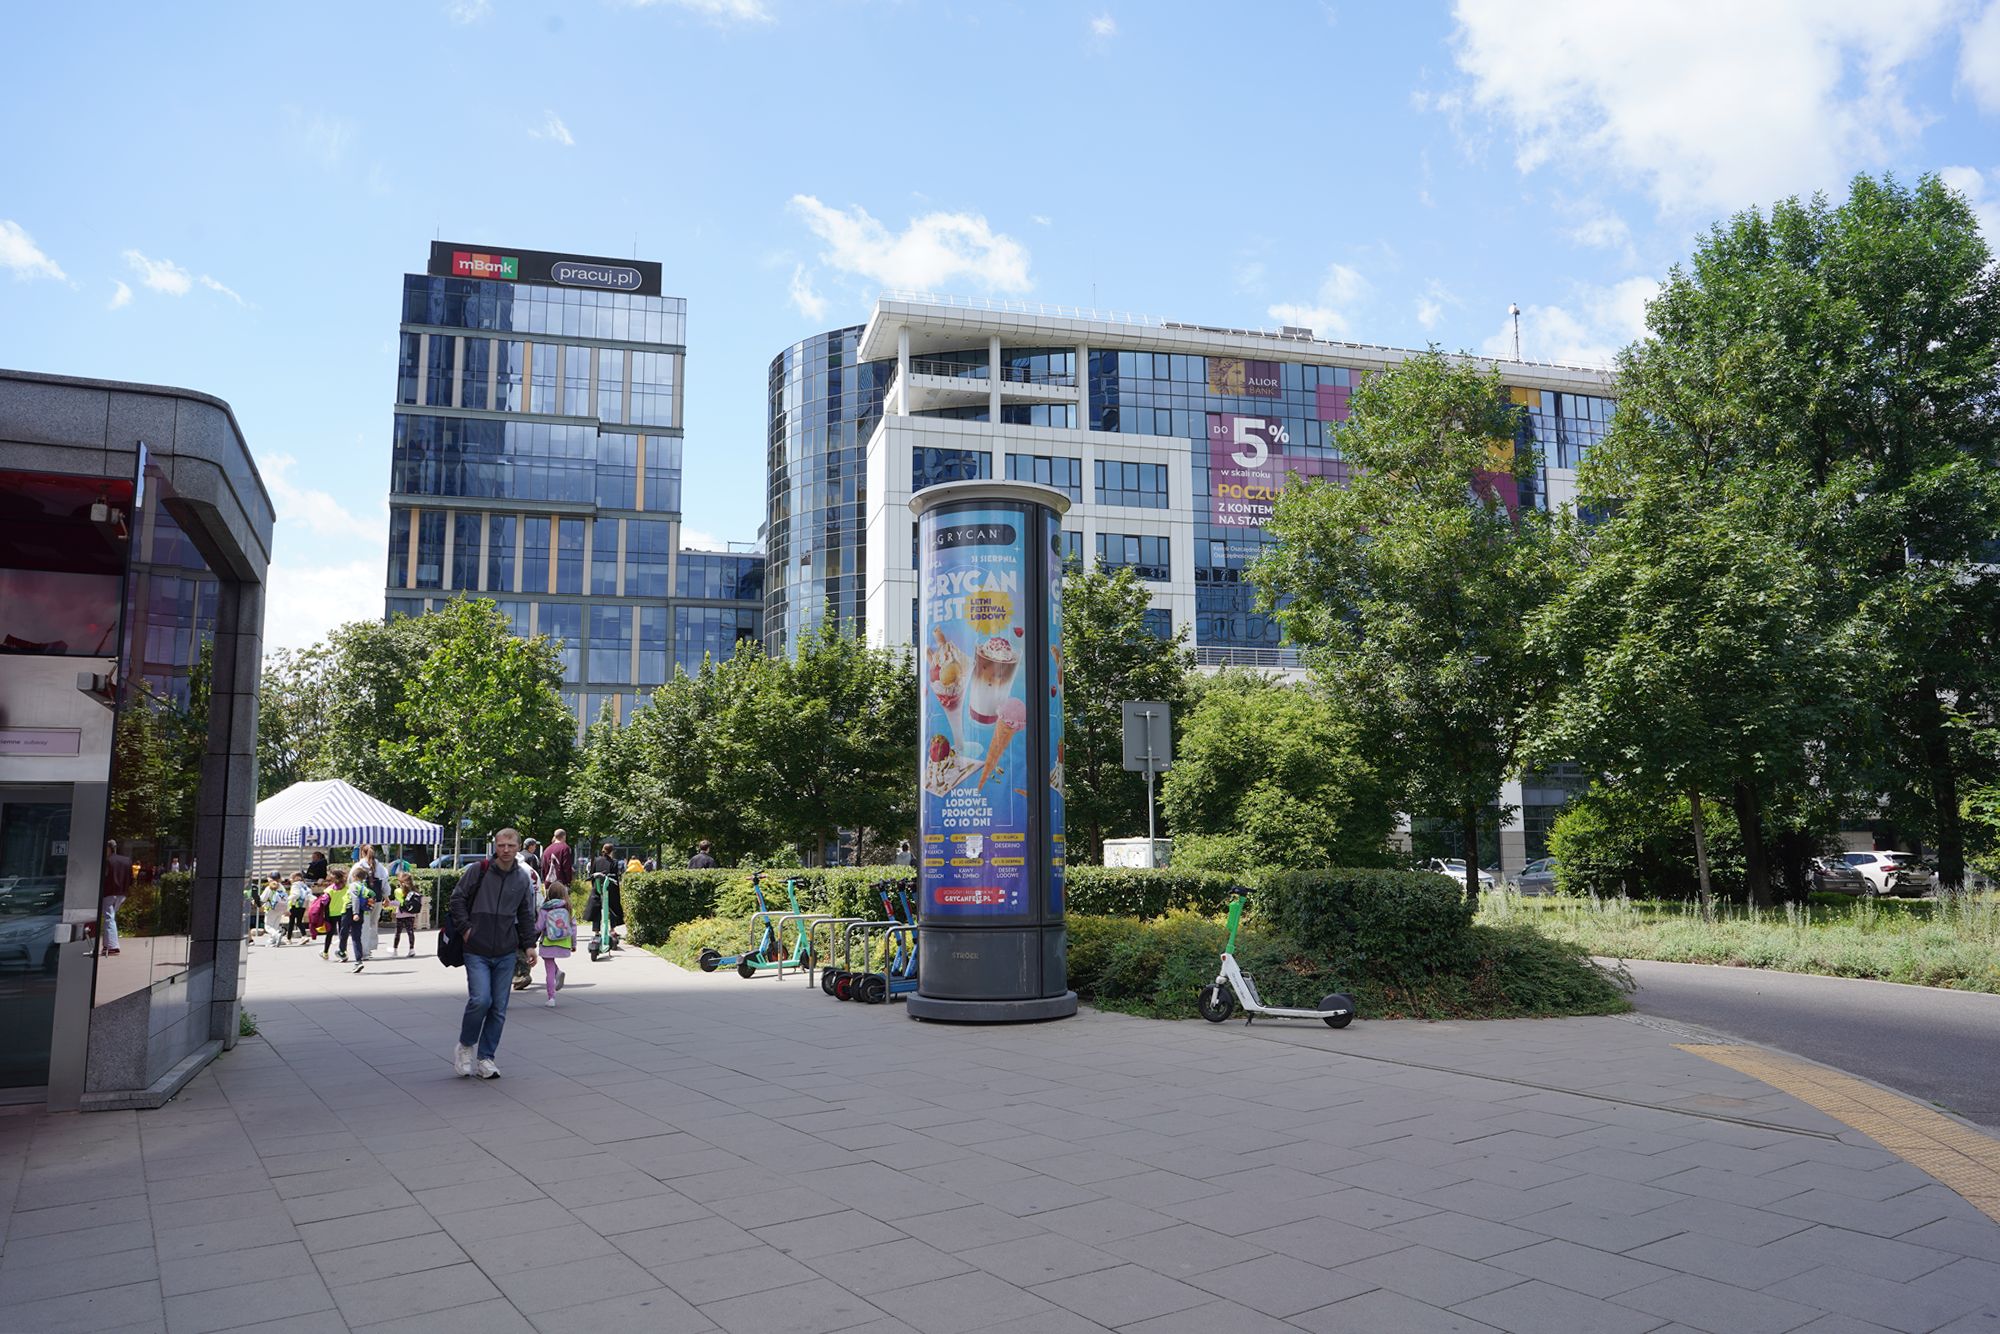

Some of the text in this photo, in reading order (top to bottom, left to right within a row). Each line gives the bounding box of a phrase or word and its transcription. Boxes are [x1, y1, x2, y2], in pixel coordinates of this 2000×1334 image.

[458, 258, 513, 274] mBank
[560, 267, 634, 287] pracuj.pl
[1248, 377, 1279, 387] ALIOR
[1249, 387, 1275, 395] BANK
[1213, 425, 1229, 434] DO
[1231, 469, 1250, 477] skali
[1252, 470, 1271, 479] roku
[1218, 483, 1285, 501] POCZU
[1218, 503, 1273, 514] Z KONTEM
[1218, 515, 1235, 525] NA
[937, 529, 999, 545] GRYCAN
[926, 570, 1016, 599] GRYCAN
[927, 597, 966, 623] FEST
[946, 797, 988, 807] LODOWE
[942, 807, 993, 817] PROMOCJE
[943, 818, 956, 827] CO
[973, 818, 991, 827] DNI
